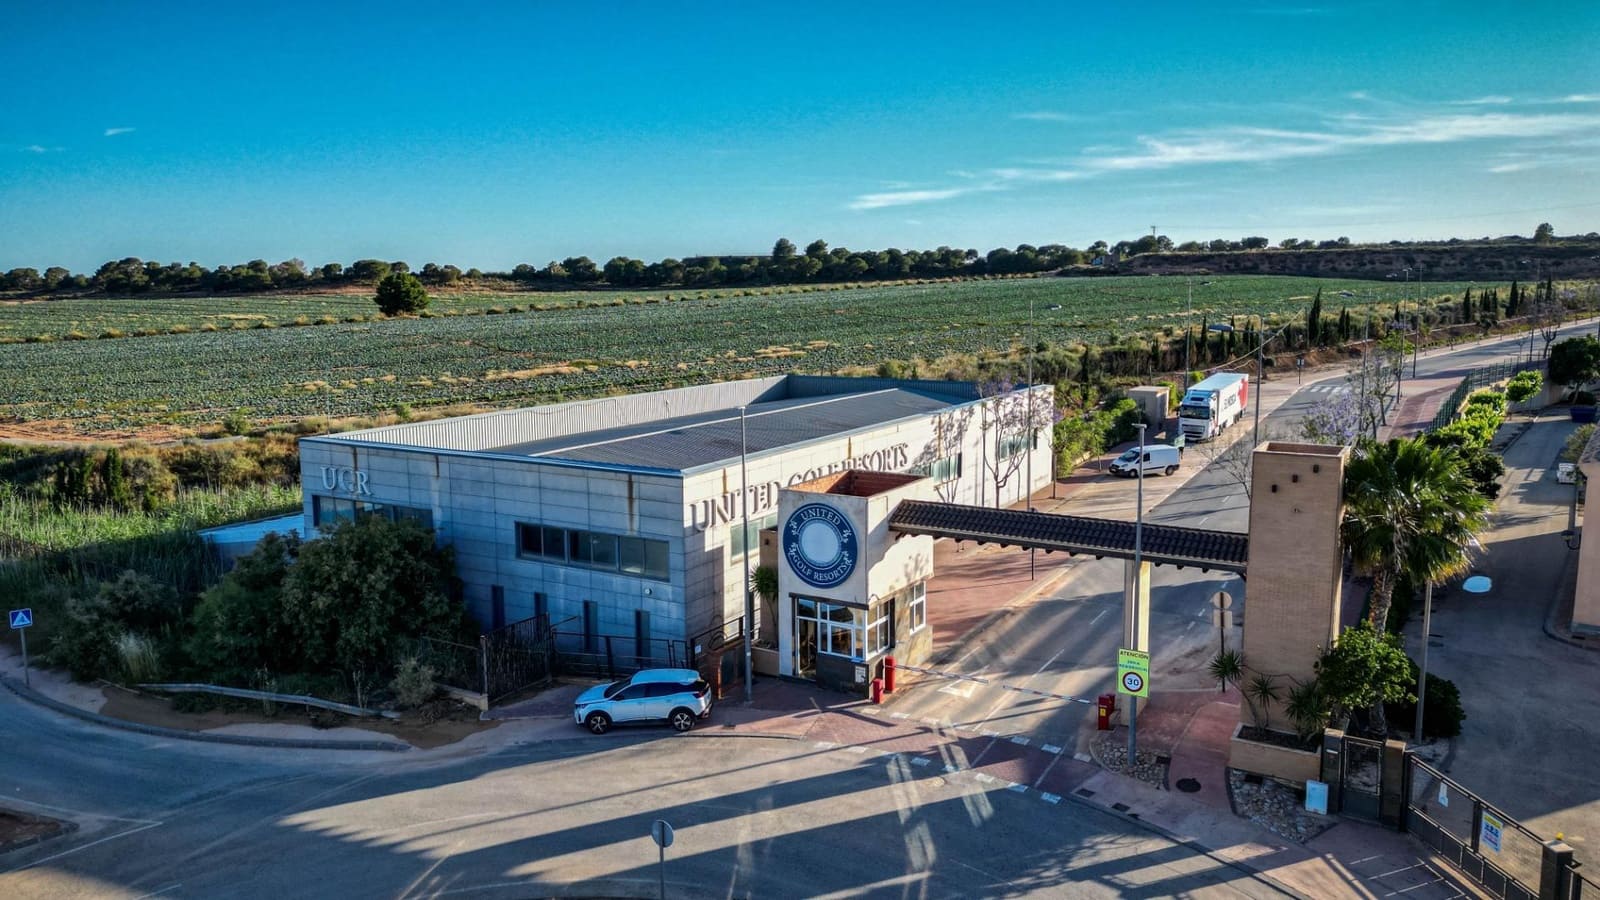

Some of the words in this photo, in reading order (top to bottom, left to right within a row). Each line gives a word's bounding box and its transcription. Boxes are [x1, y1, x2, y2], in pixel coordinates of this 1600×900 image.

[690, 482, 781, 532] UNITED
[801, 508, 840, 525] UNITED
[793, 554, 812, 576] GOLF
[813, 563, 847, 581] RESORTS
[1127, 678, 1139, 686] 30
